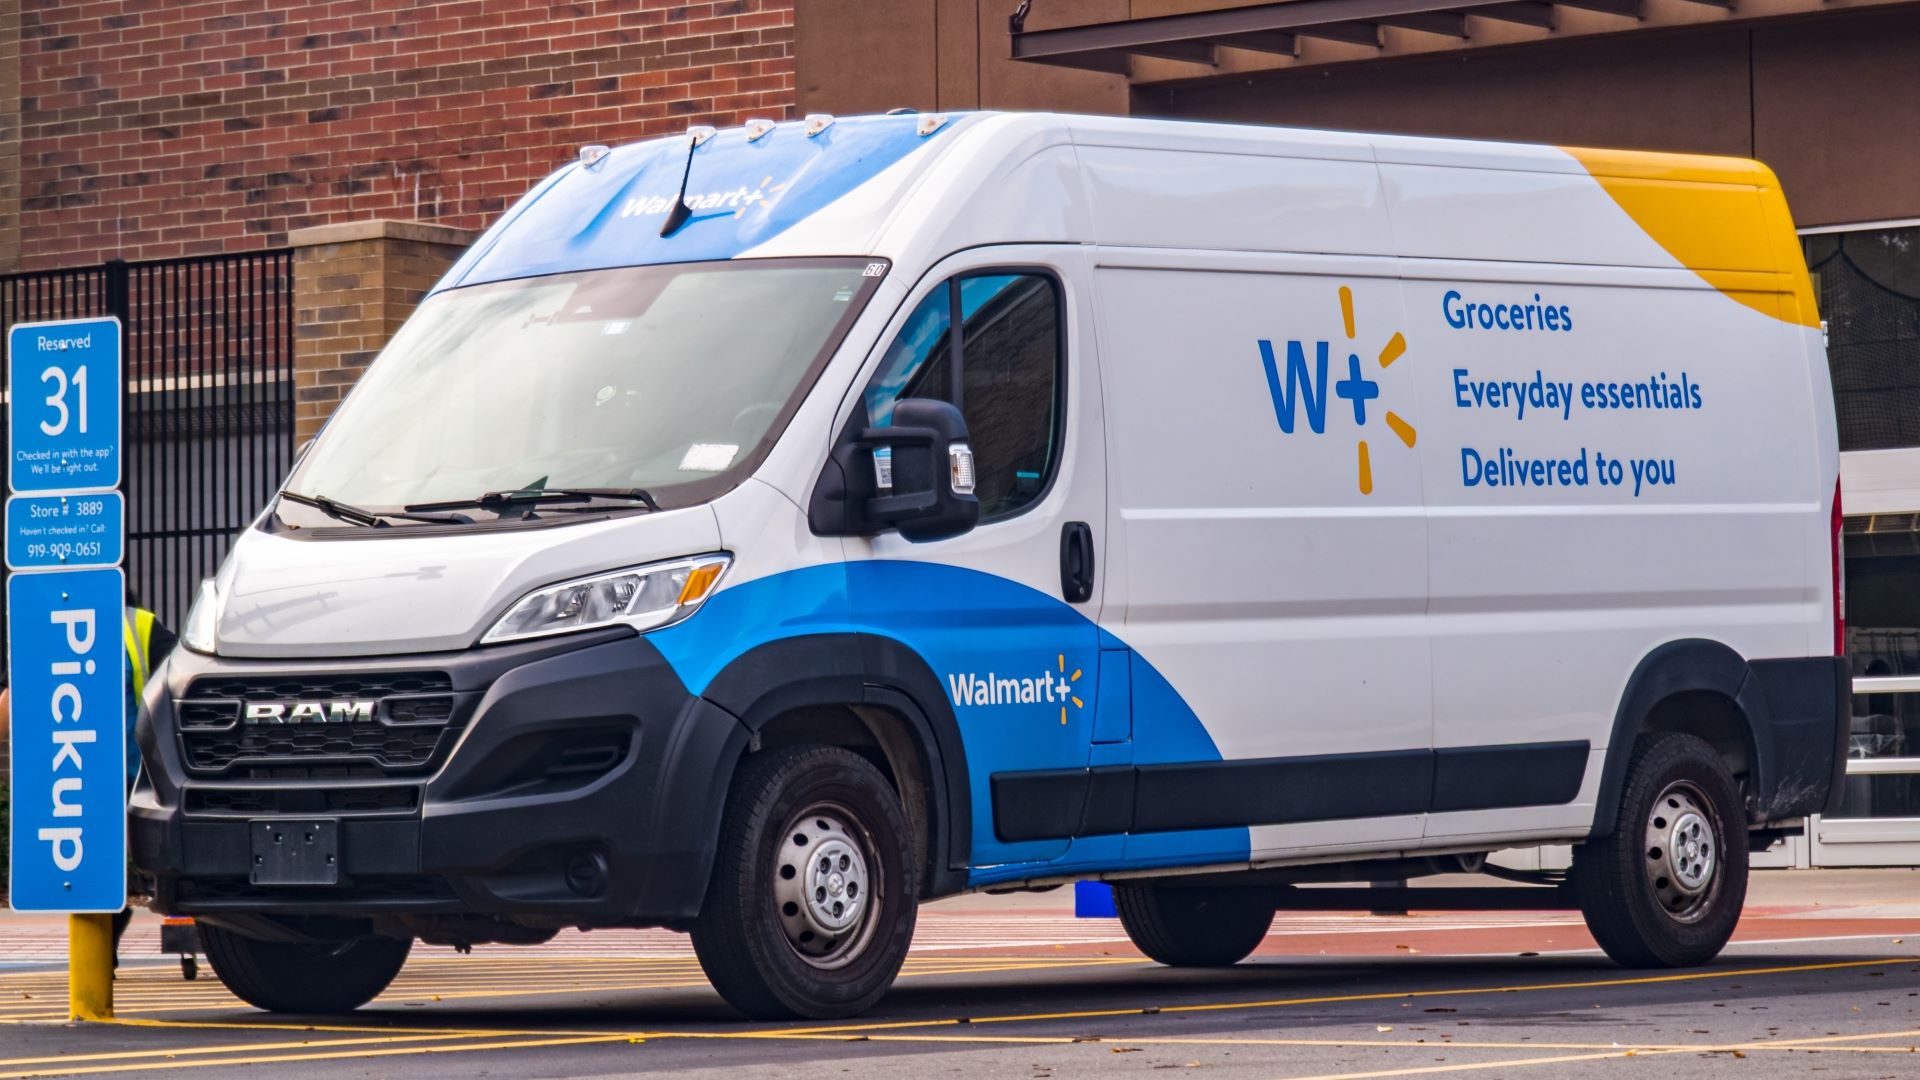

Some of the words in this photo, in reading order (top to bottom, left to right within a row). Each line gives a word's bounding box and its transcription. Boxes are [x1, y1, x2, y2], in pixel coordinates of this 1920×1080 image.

[1442, 290, 1573, 332] Groceries
[38, 334, 91, 351] Reserved
[40, 365, 88, 436] 31
[1453, 368, 1573, 420] Everyday
[1581, 372, 1703, 410] essentials
[16, 450, 51, 462] Checked
[52, 450, 60, 459] in
[61, 448, 79, 459] with
[80, 447, 94, 458] the
[95, 445, 114, 460] app?
[51, 464, 61, 474] be
[1460, 448, 1589, 487] Delivered
[1596, 452, 1624, 486] to
[1630, 459, 1676, 497] you
[30, 504, 60, 518] Store
[62, 504, 69, 516] #
[76, 501, 103, 516] 3889
[48, 525, 77, 536] checked
[78, 524, 89, 534] in?
[28, 541, 101, 559] 919-909-0651
[245, 701, 374, 724] RAM
[38, 608, 96, 872] Pickup
